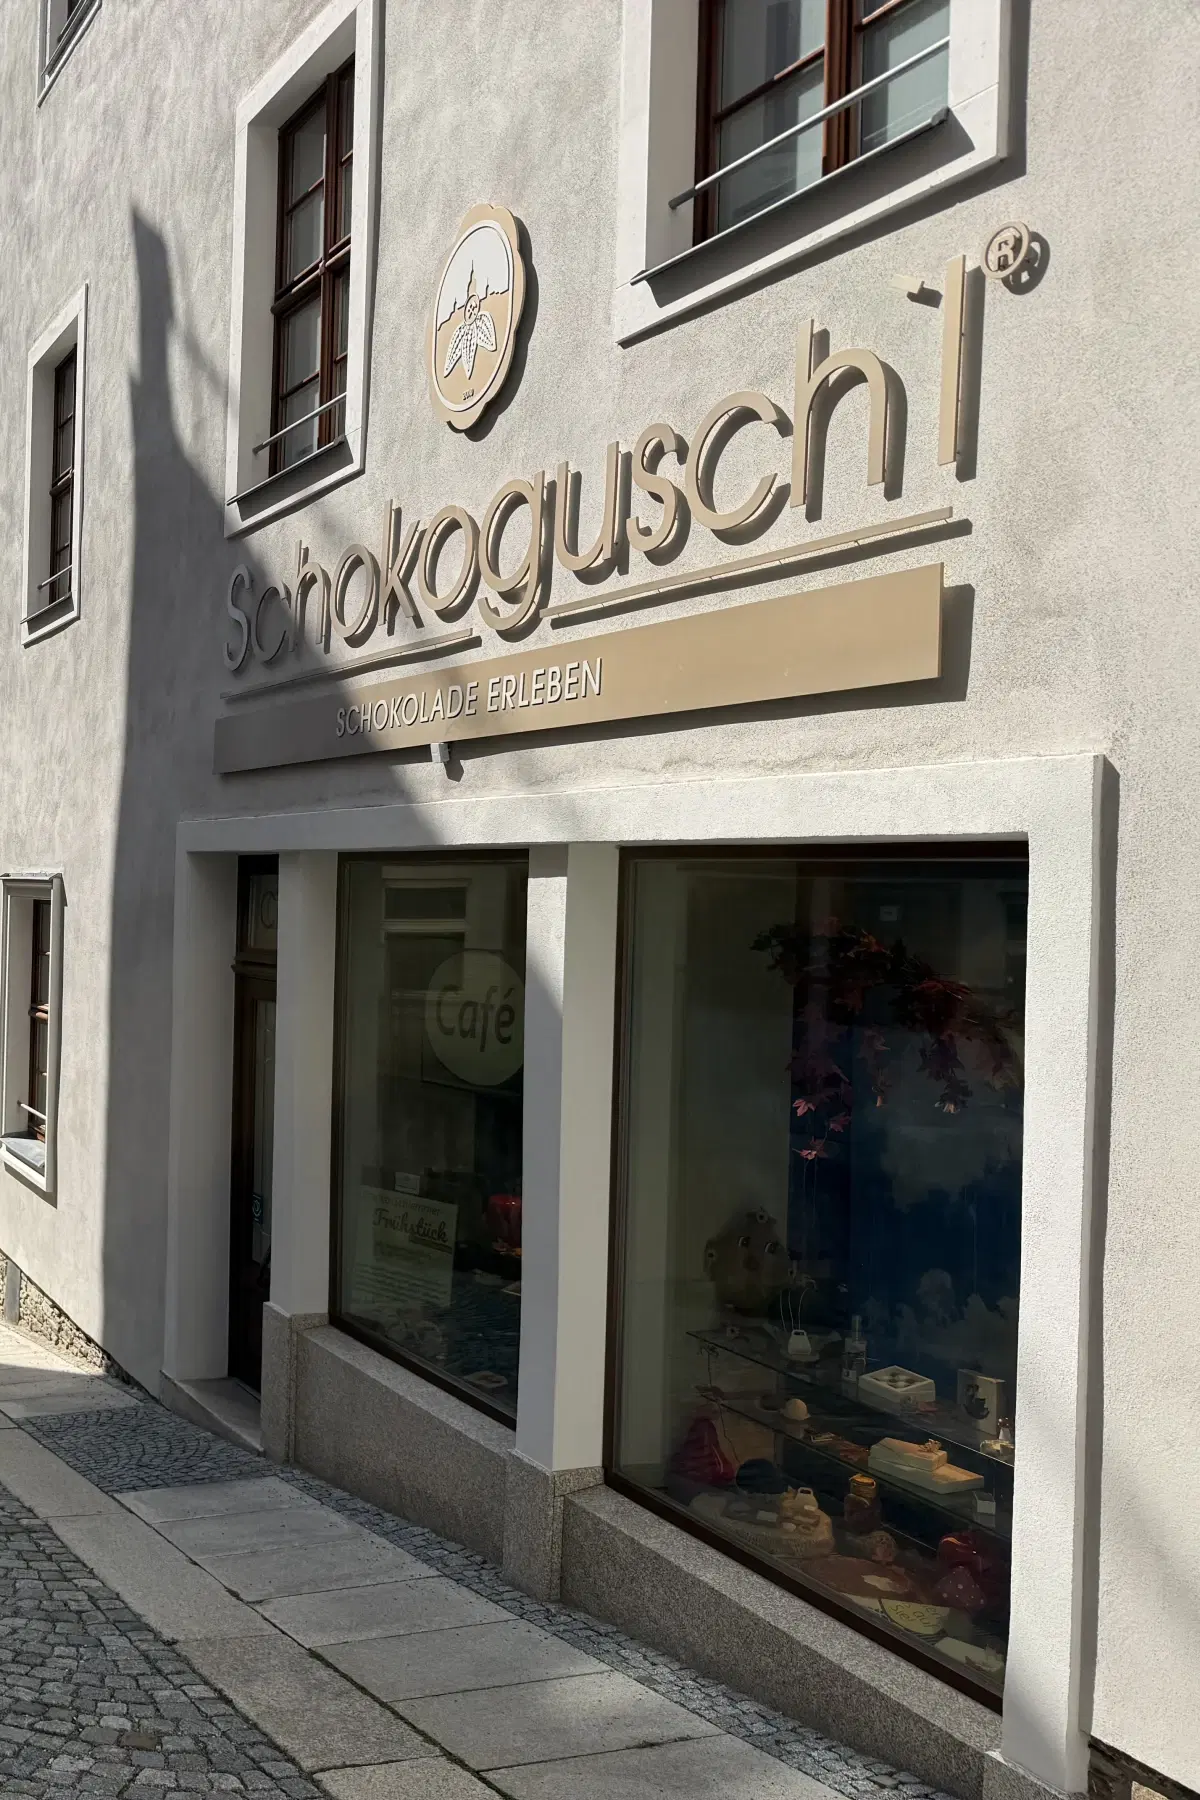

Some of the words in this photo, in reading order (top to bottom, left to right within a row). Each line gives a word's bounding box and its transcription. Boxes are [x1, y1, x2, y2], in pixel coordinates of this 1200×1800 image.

[335, 681, 480, 738] SCHOKOLADE
[487, 657, 603, 713] ERLEBEN
[435, 984, 516, 1053] Café
